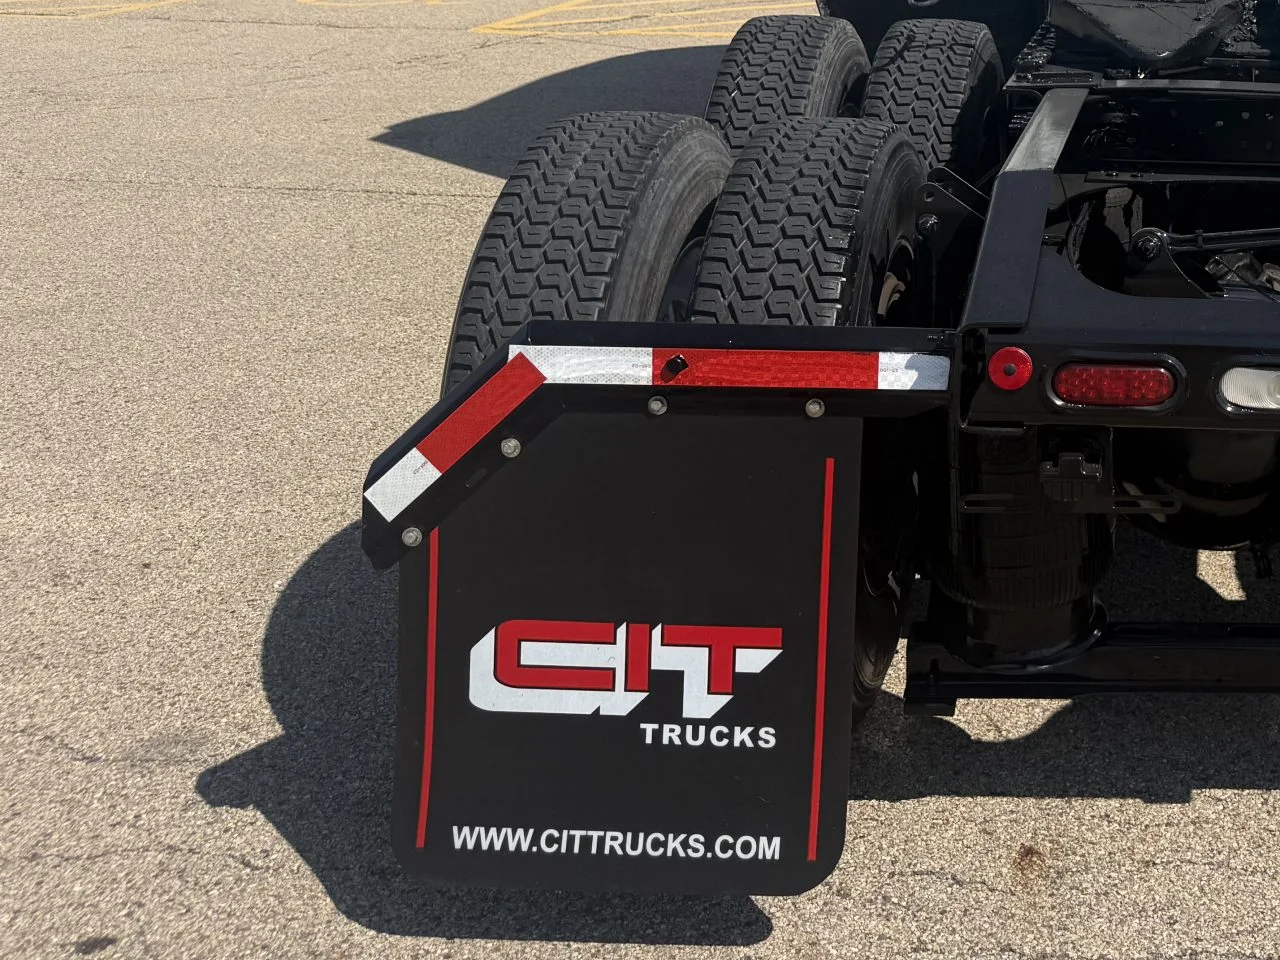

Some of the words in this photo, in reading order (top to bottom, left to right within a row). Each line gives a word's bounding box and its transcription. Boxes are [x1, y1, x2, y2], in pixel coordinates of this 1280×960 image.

[469, 619, 783, 718] CIT
[639, 723, 777, 748] TRUCKS
[452, 825, 781, 860] WWW.CITTRUCKS.COM
